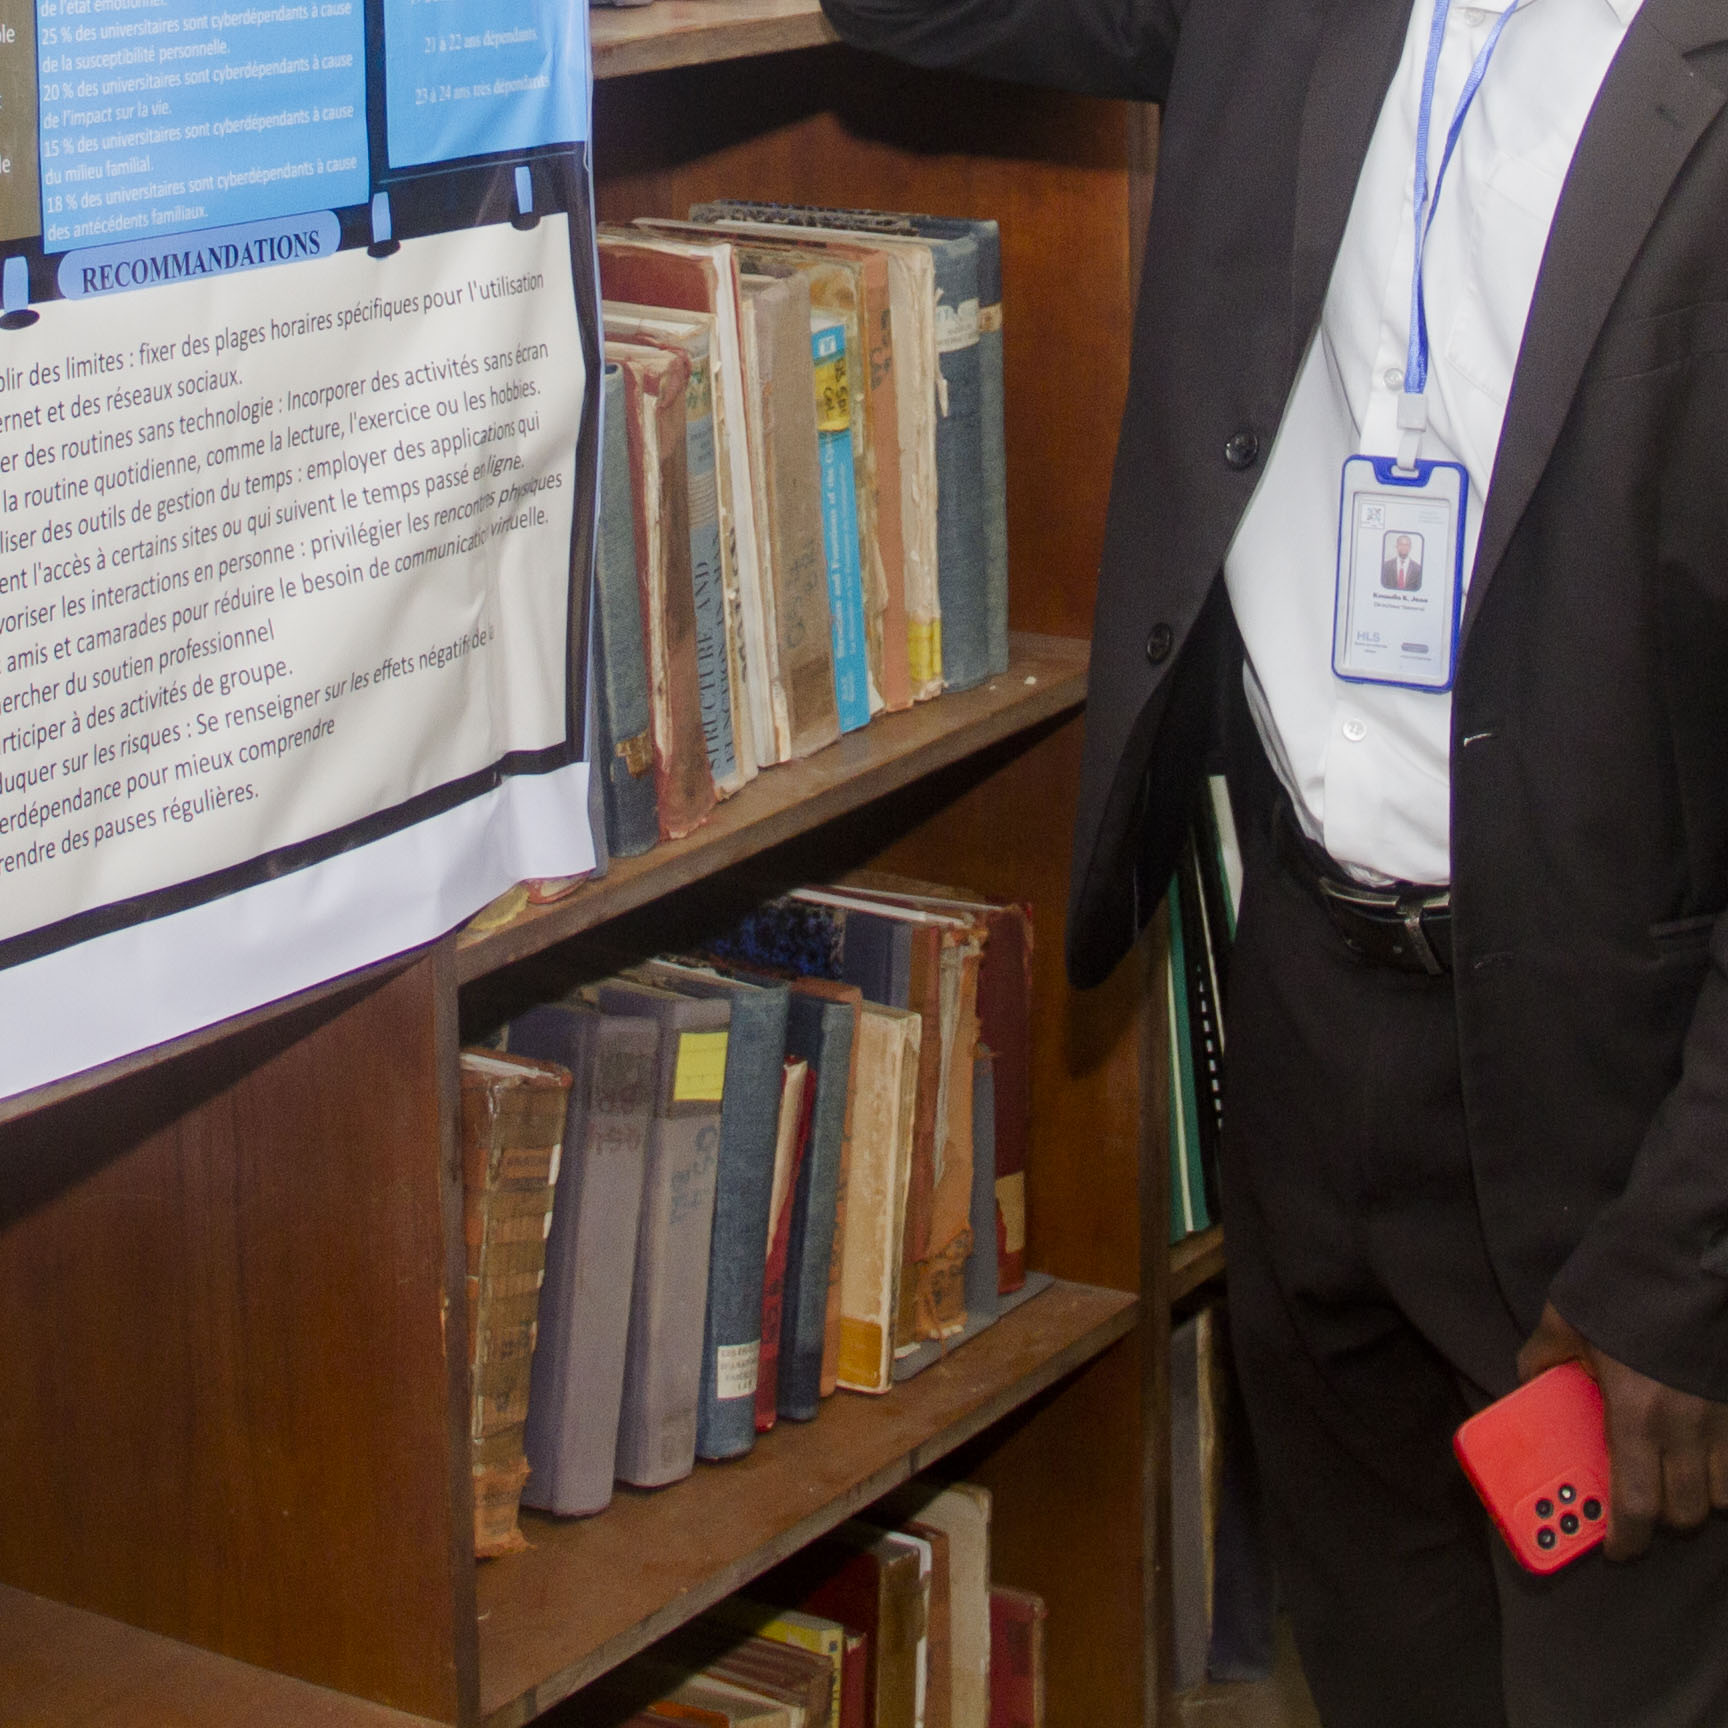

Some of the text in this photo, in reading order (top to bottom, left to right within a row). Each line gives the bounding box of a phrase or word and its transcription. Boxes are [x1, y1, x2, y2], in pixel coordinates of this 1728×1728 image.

[81, 229, 321, 294] RECOMMANDATIONS
[46, 400, 66, 424] et
[70, 394, 101, 420] des
[106, 383, 173, 412] réseaux
[177, 369, 243, 398] sociaux.
[126, 766, 169, 800] pour
[174, 750, 234, 781] mieux
[238, 717, 335, 764] comprendre
